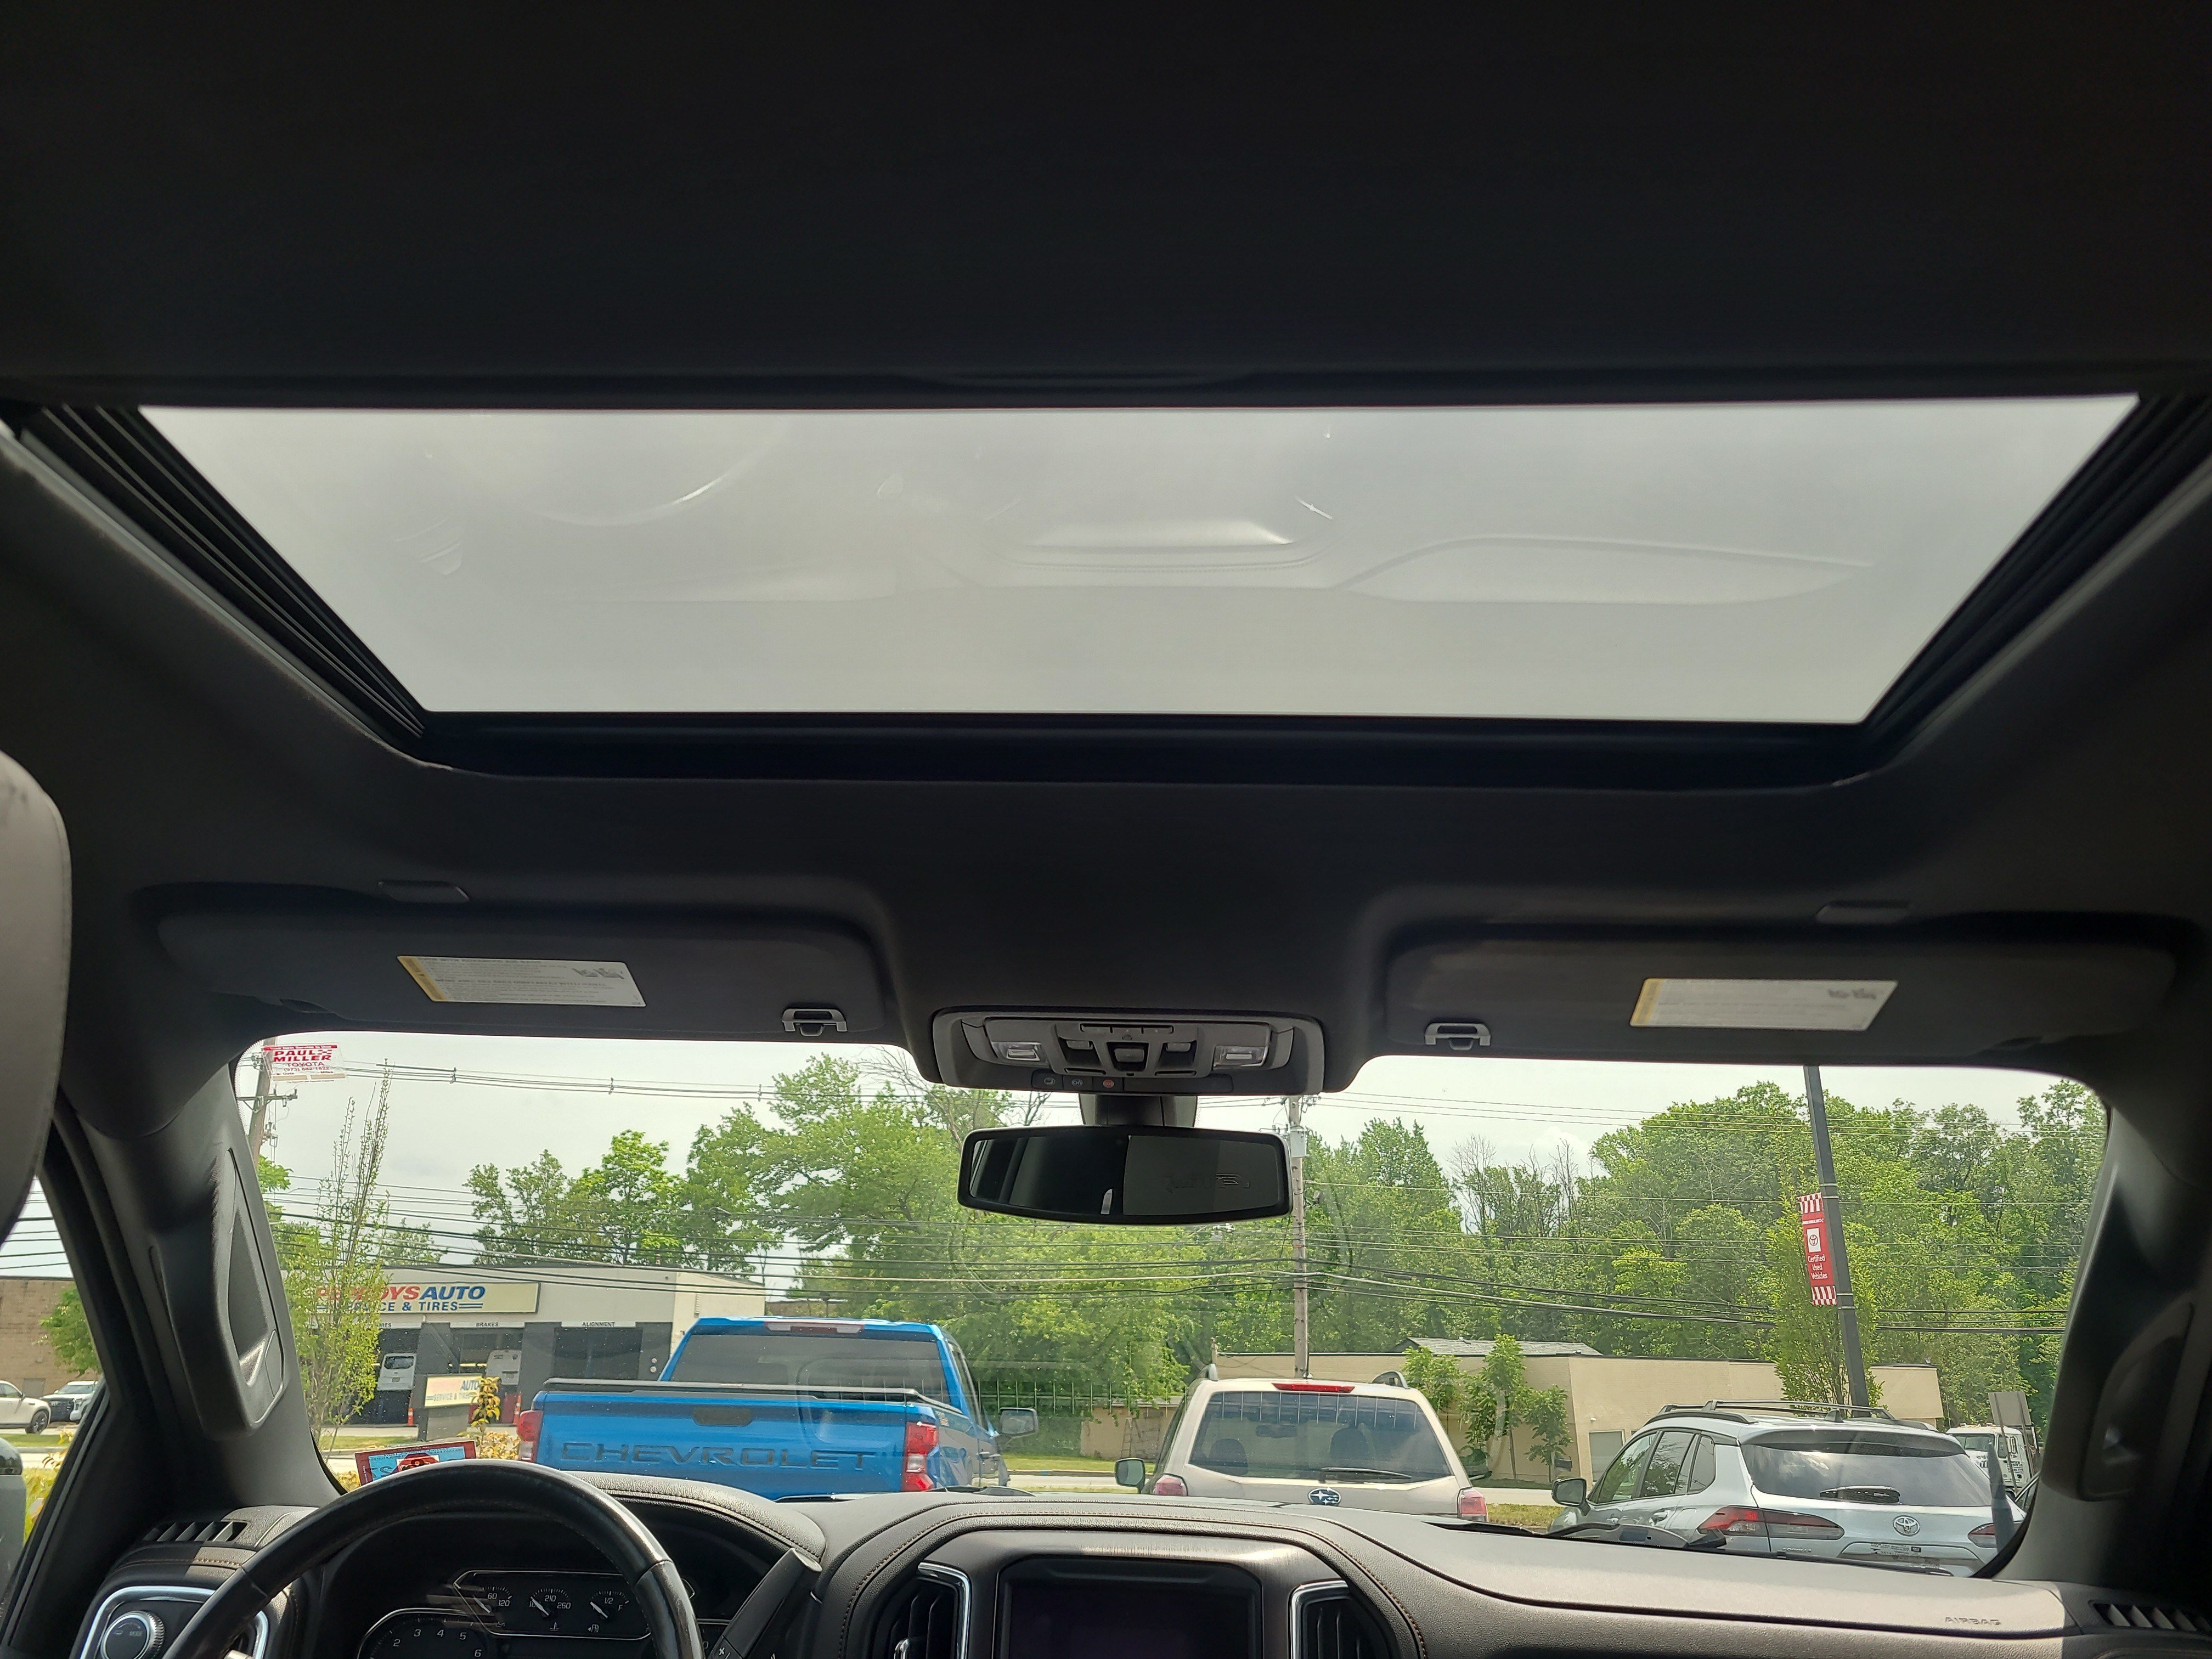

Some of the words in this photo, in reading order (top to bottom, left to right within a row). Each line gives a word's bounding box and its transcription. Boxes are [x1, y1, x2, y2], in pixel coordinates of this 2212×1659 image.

[1807, 1254, 1826, 1262] Certified
[1812, 1263, 1823, 1271] Used
[402, 1302, 412, 1311] &
[418, 1301, 459, 1311] TIRES
[460, 1380, 480, 1391] AUTO
[561, 1442, 876, 1470] CHEVROLET
[1945, 1617, 2001, 1626] AIRBAG
[414, 1629, 421, 1637] 3
[393, 1639, 401, 1647] 2
[475, 1649, 482, 1657] 6
